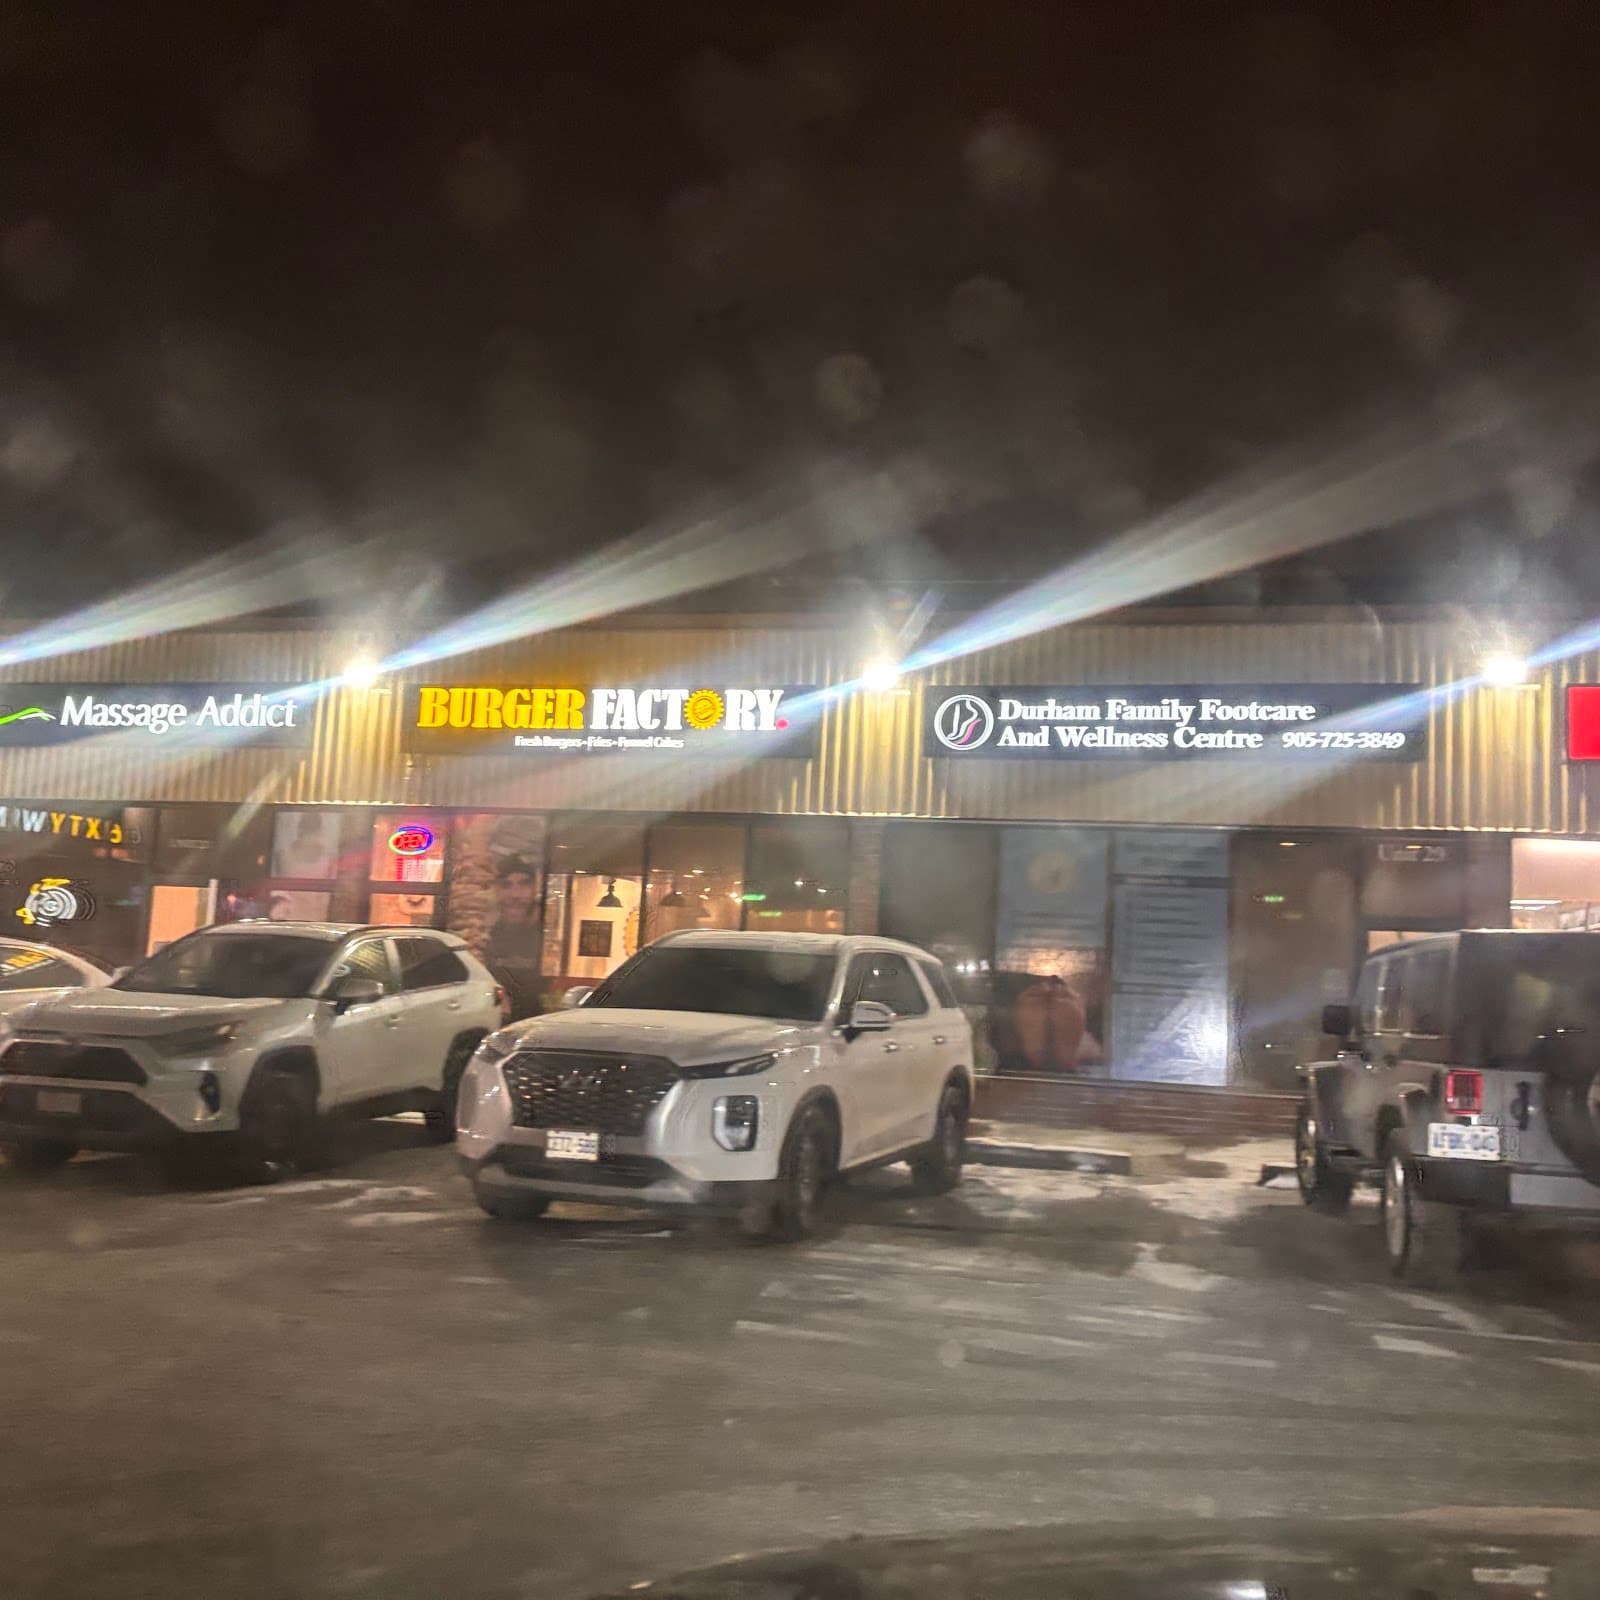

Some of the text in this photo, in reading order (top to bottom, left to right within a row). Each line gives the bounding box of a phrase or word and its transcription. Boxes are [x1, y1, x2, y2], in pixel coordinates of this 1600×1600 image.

[61, 693, 297, 734] Massage Addict
[416, 687, 586, 730] BURGER
[998, 698, 1317, 727] Durham Family Footcare
[997, 725, 1051, 747] And
[1054, 726, 1169, 748] Wellness
[1173, 726, 1264, 749] Centre
